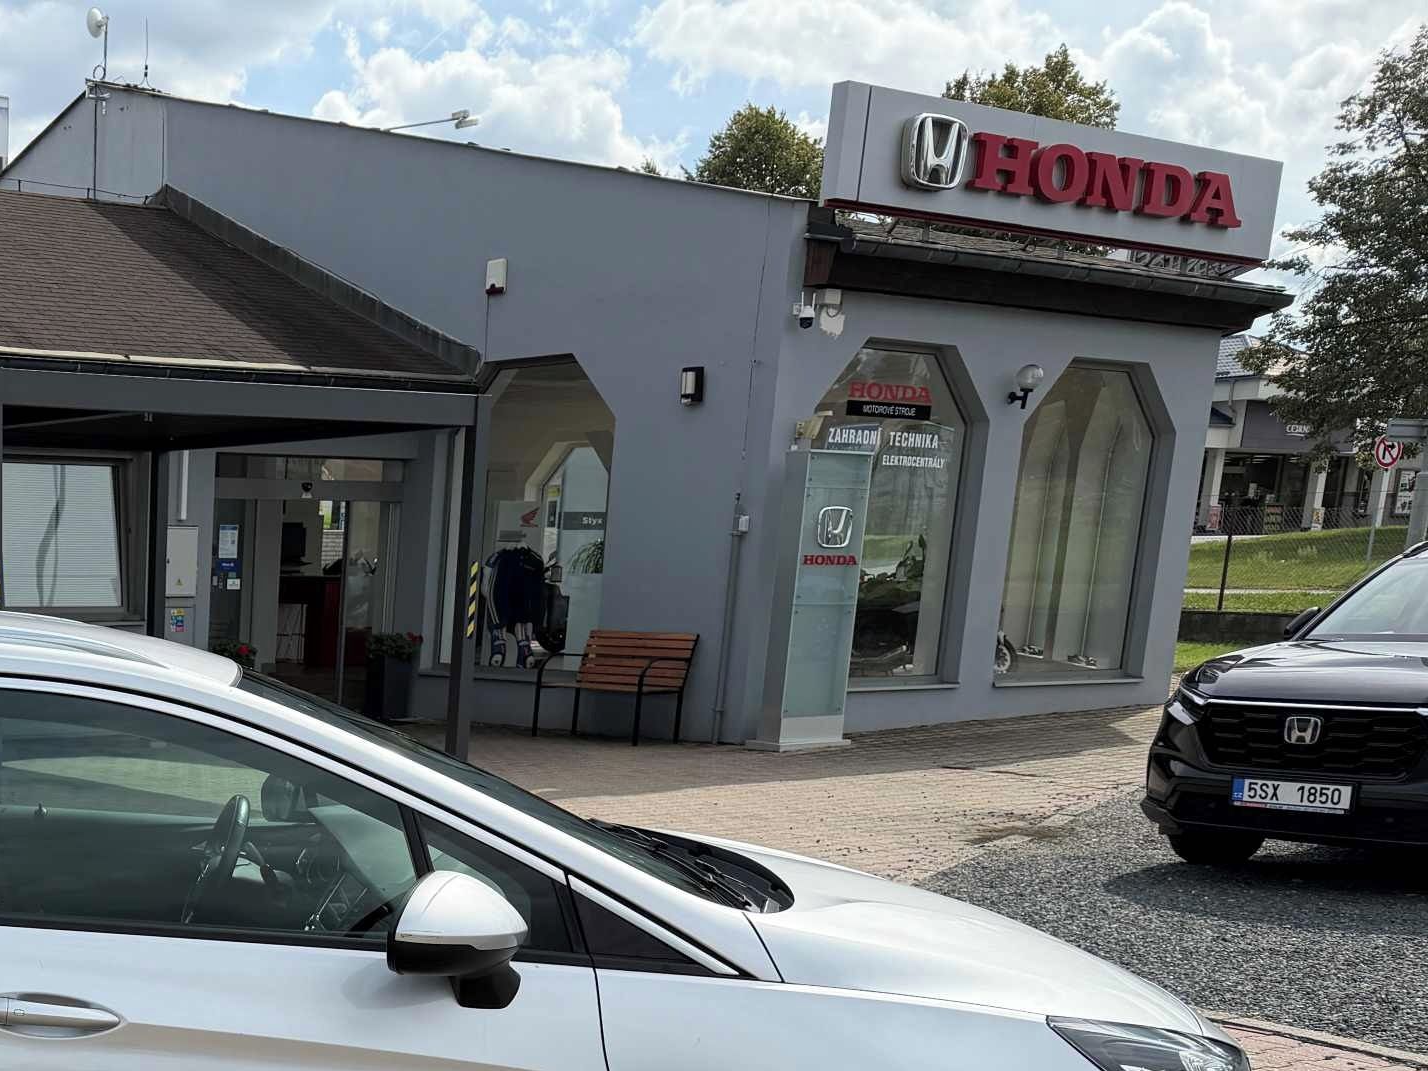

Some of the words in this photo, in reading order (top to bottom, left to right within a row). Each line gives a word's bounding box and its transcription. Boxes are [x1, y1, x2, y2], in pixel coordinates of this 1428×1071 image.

[967, 131, 1242, 229] HONDA
[847, 381, 932, 404] HONDA
[828, 427, 882, 446] ZAHRADNÍ
[889, 431, 939, 449] TECHNIKA
[882, 454, 945, 469] ELEKTROCENTRÁLY
[803, 555, 857, 566] HONDA
[1247, 781, 1281, 801] 5SX
[1296, 785, 1342, 806] 1850
